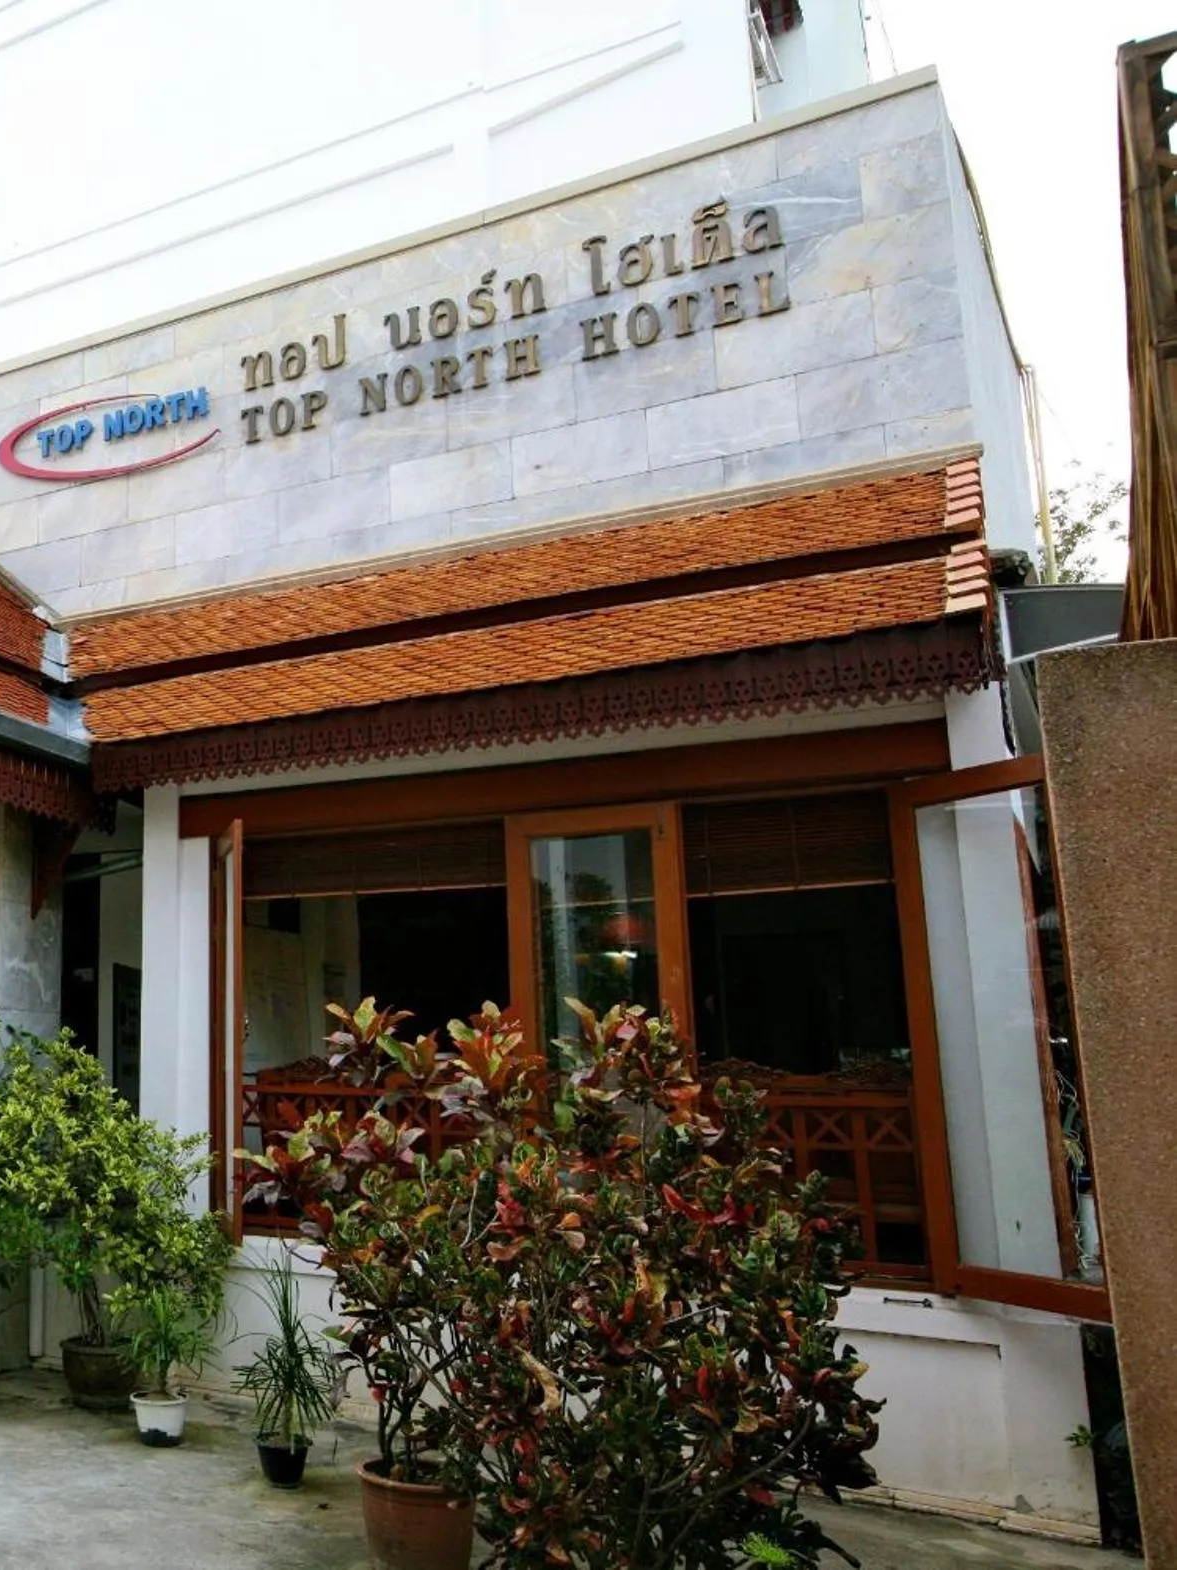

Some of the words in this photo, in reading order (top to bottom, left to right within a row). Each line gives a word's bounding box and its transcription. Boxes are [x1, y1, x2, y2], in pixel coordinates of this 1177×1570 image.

[241, 313, 347, 391] ทอป
[384, 268, 547, 350] นอร์ท
[582, 195, 786, 296] โฮเต็ล
[241, 390, 328, 444] TOP
[358, 334, 541, 417] NORTH
[579, 271, 791, 361] HOTEL
[36, 419, 95, 458] TOP
[103, 386, 211, 442] NORTH
